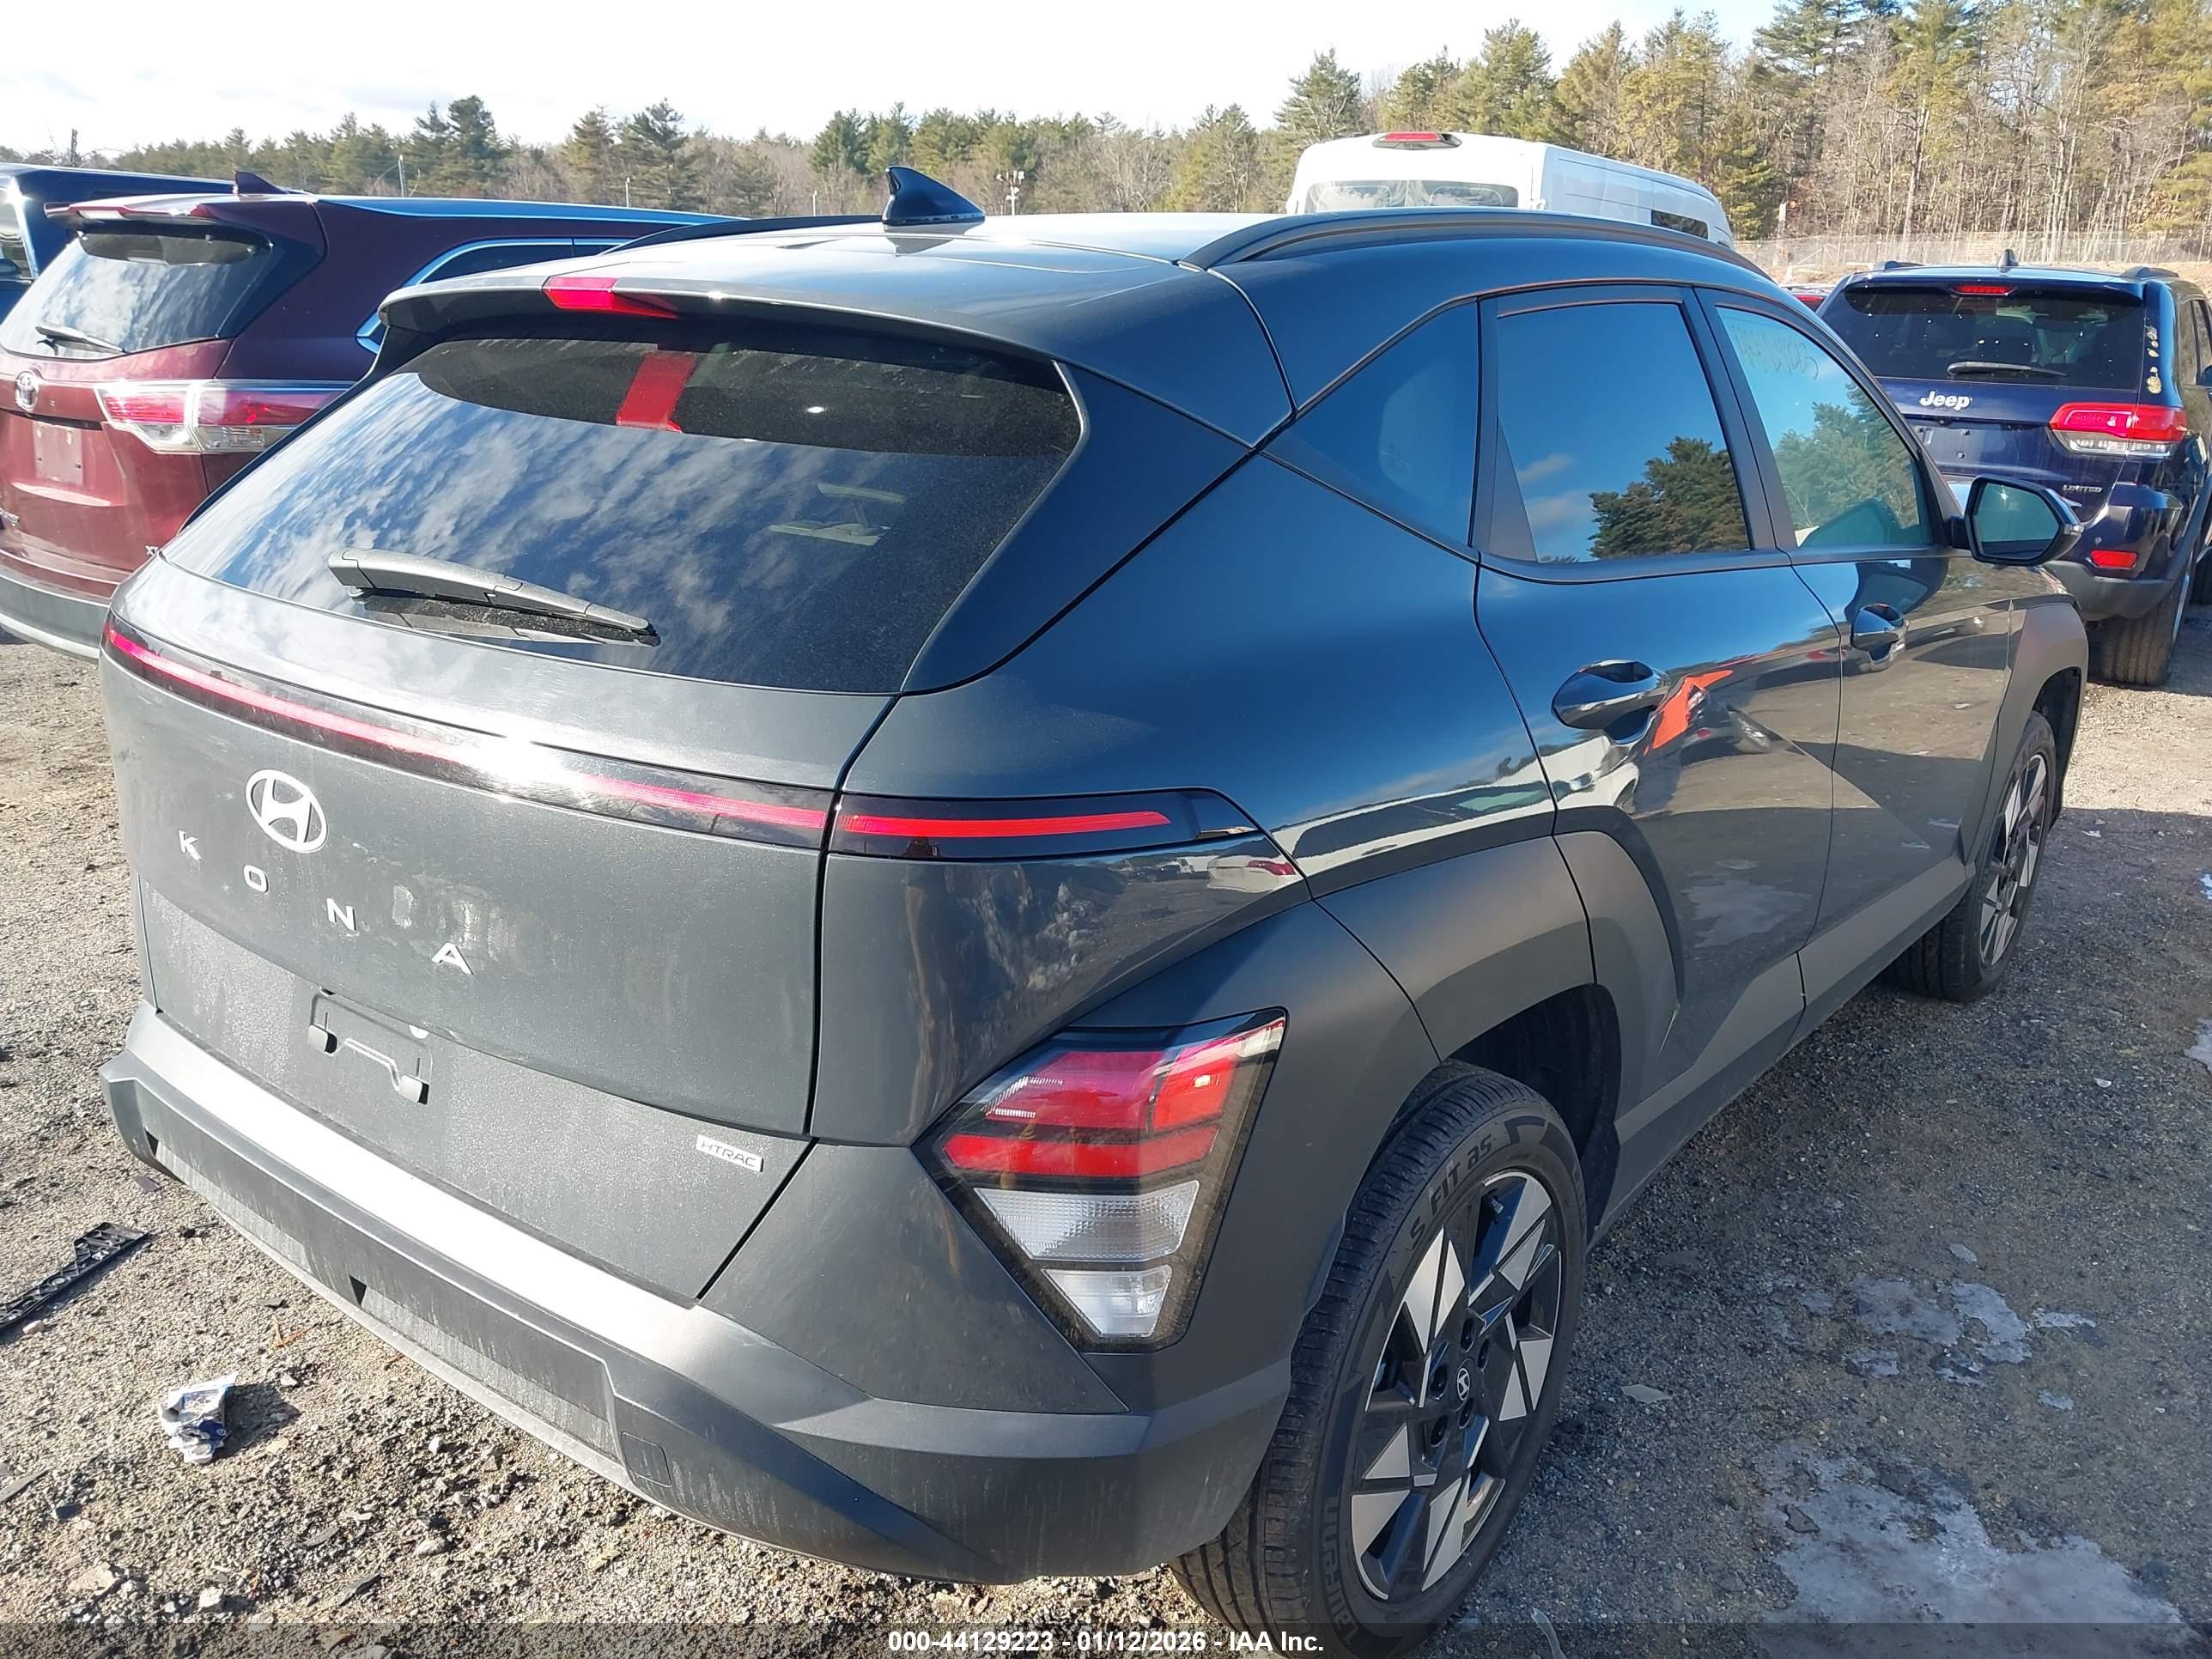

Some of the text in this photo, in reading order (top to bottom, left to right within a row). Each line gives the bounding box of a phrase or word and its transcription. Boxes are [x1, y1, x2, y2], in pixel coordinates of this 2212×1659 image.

[1919, 391, 1971, 411] Jeep
[178, 830, 474, 975] KONA
[701, 1140, 757, 1168] HTRAC
[1431, 1161, 1462, 1217] FIT
